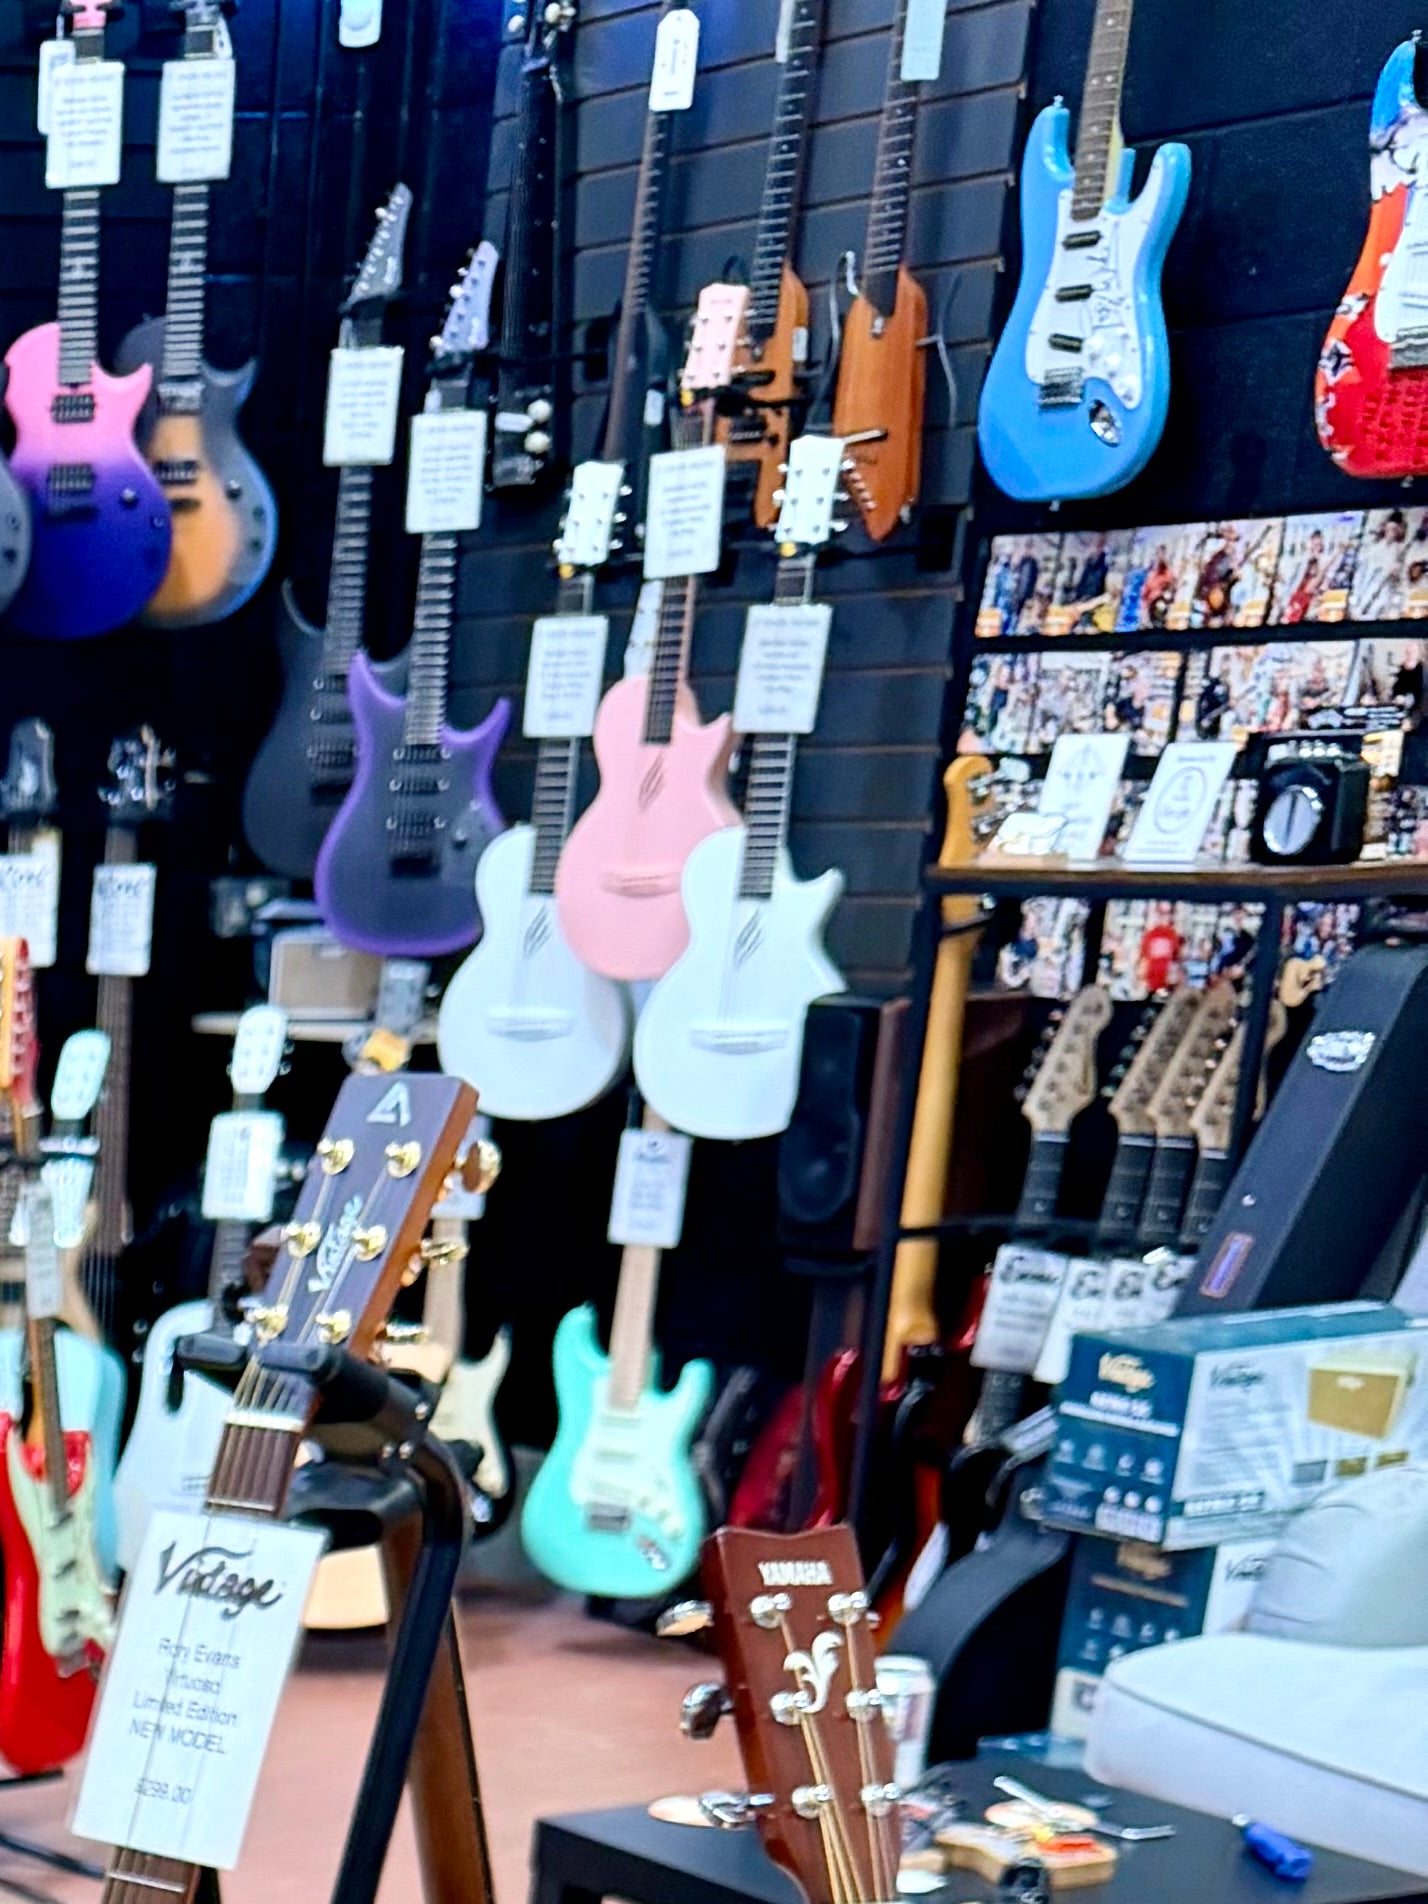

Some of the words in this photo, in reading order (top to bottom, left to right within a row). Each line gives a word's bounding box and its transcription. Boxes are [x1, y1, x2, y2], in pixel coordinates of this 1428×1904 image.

[155, 1541, 284, 1621] Vintage
[758, 1560, 832, 1585] YAMAHA
[169, 1725, 227, 1754] MODEL
